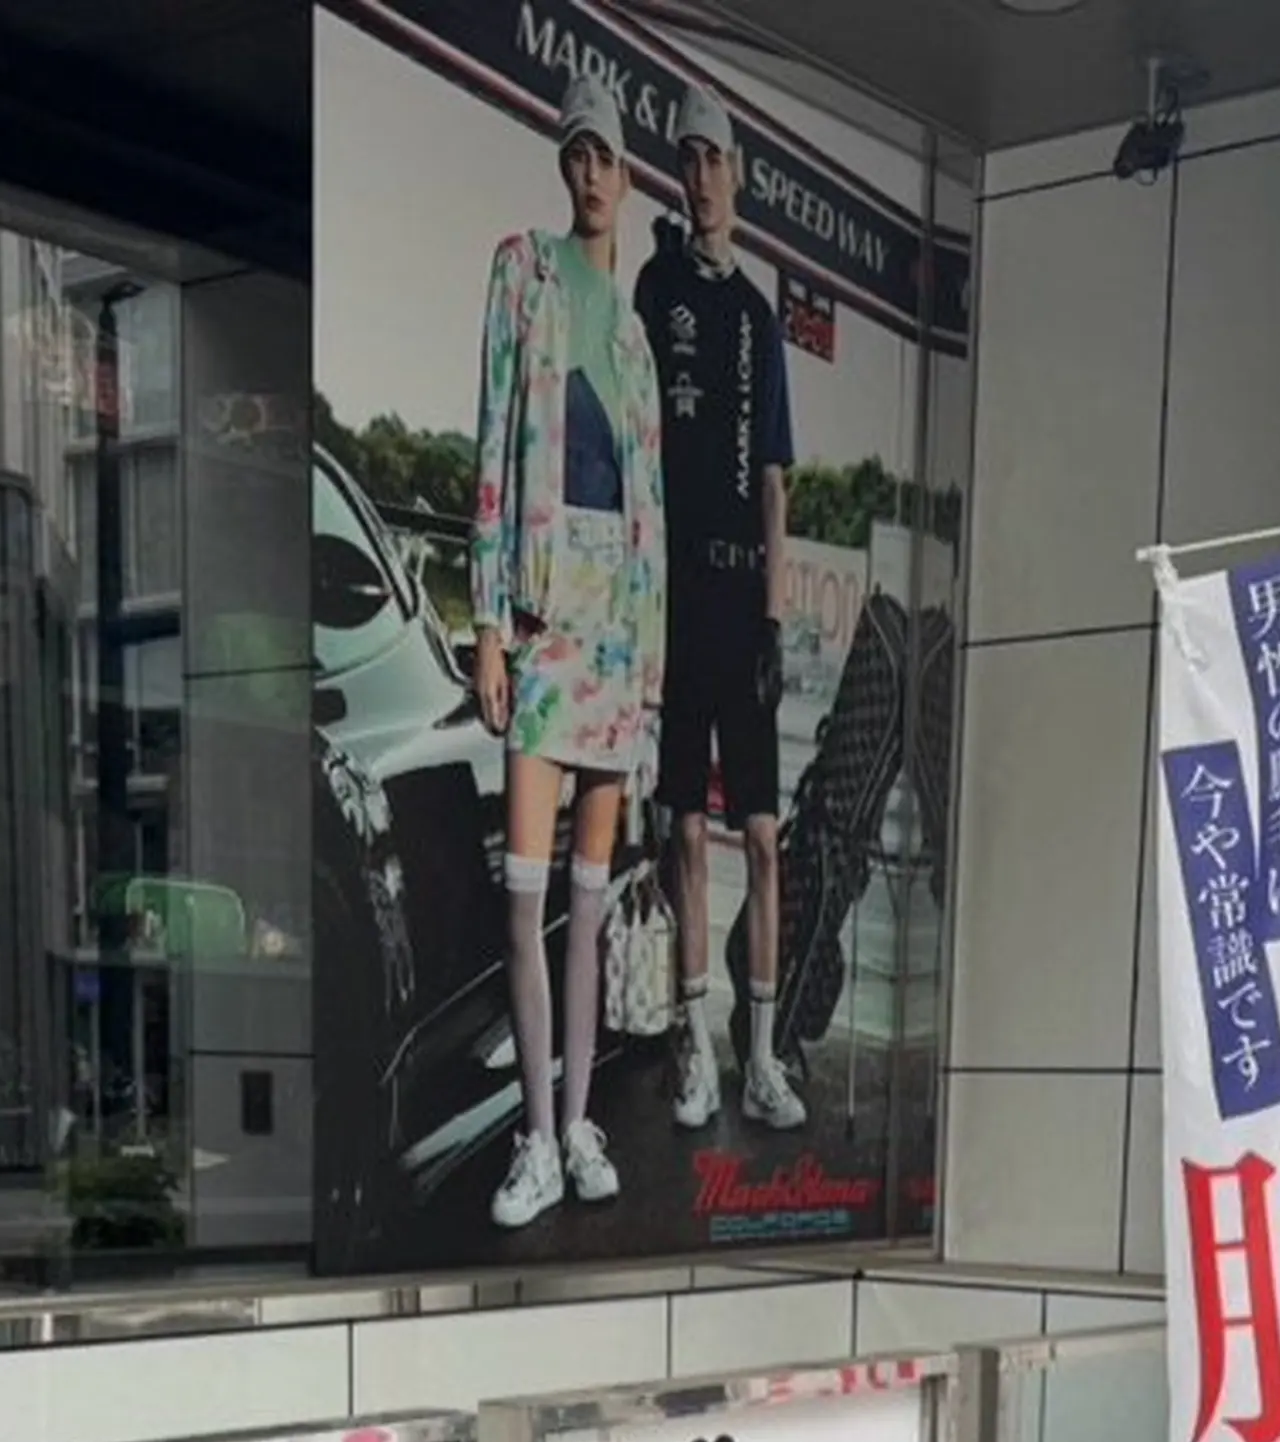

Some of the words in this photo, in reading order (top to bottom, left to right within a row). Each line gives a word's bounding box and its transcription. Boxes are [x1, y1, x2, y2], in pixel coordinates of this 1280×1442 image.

[635, 83, 659, 134] &
[751, 155, 889, 272] SPEEDWAY
[1180, 763, 1271, 1092] 今や常識です
